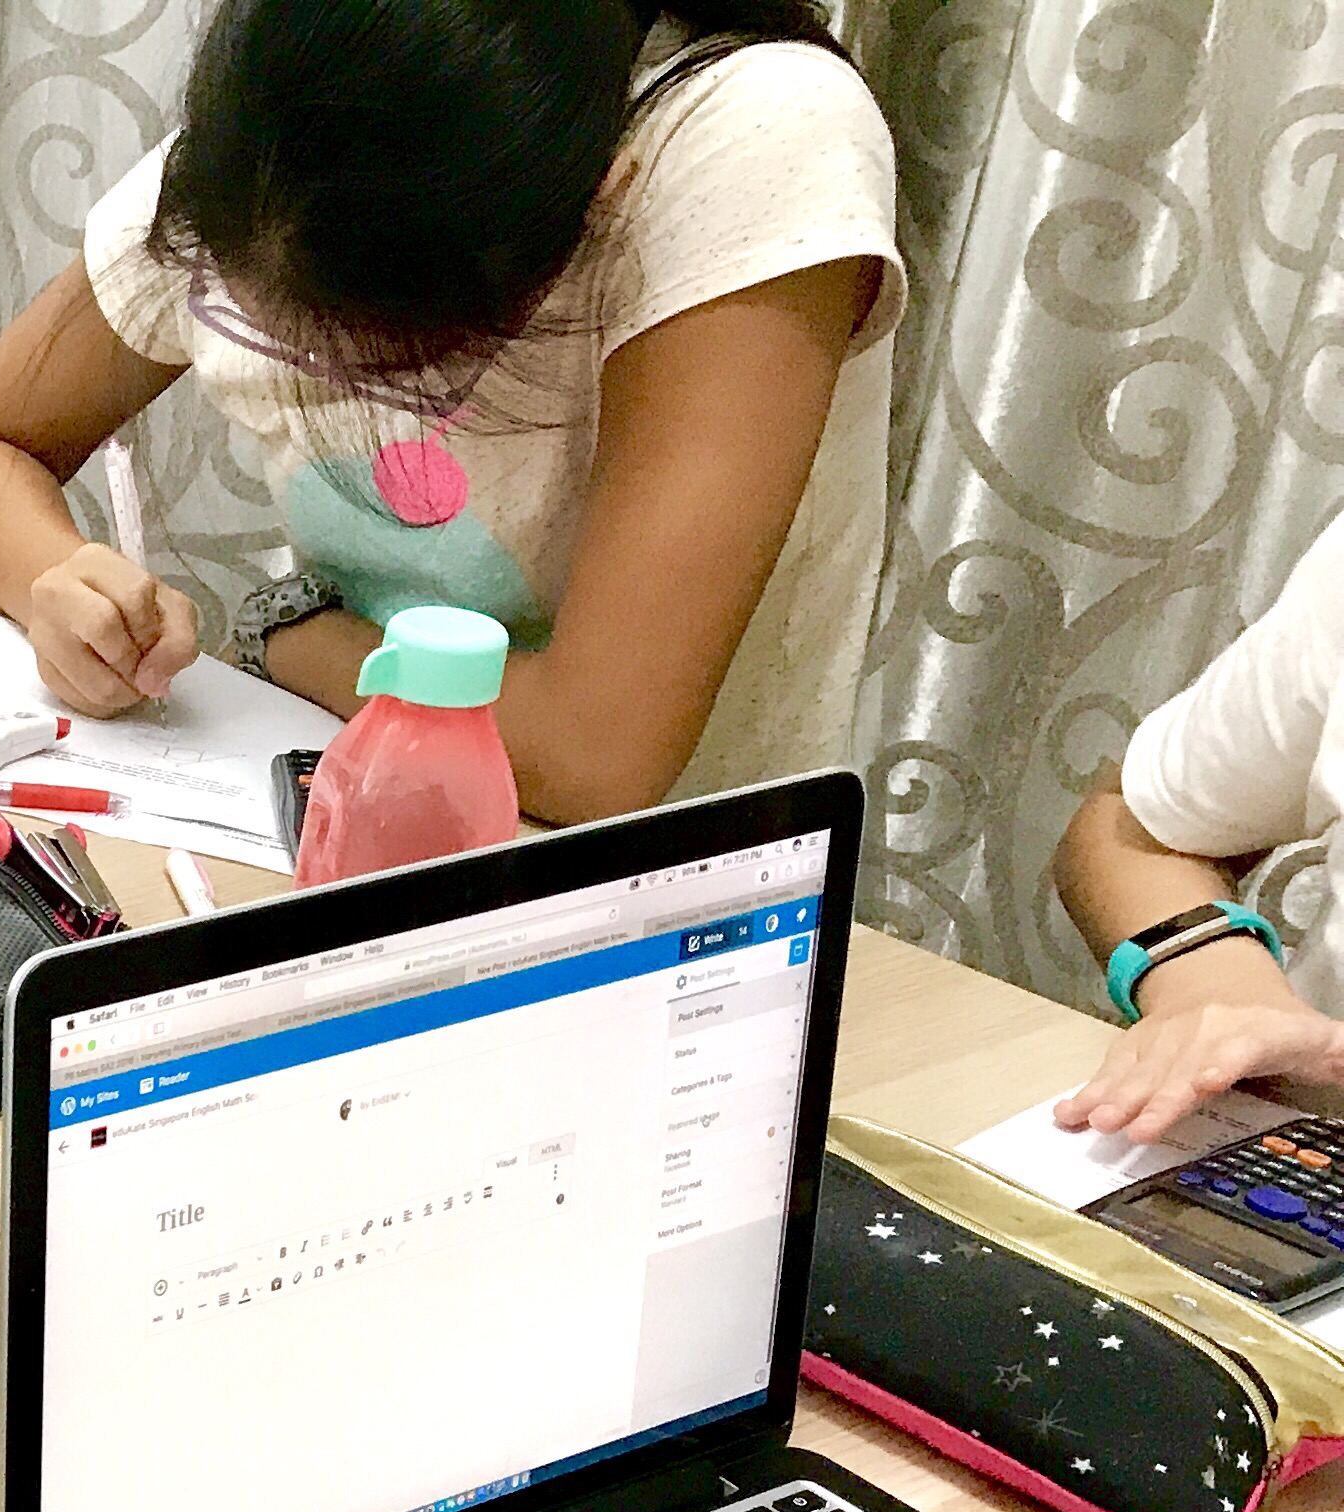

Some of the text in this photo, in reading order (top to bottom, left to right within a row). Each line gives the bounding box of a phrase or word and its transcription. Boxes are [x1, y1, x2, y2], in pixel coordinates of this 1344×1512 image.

[722, 856, 733, 867] Fri
[751, 849, 763, 861] PM
[704, 931, 724, 945] Write
[89, 943, 384, 1024] Safari File Edit View History Bookmarks Window Help
[689, 964, 736, 984] Post Settings
[678, 1002, 724, 1022] Post Settings
[674, 1047, 697, 1059] Status
[80, 1071, 190, 1110] My Sites Reader
[671, 1072, 733, 1096] Categories Tags
[148, 1110, 189, 1131] Singapore
[191, 1100, 220, 1118] English
[222, 1094, 243, 1109] Math
[496, 1143, 562, 1169] Visual HTML
[665, 1148, 692, 1162] Sharing
[661, 1179, 702, 1198] Post Format
[156, 1204, 205, 1234] Title
[658, 1220, 702, 1239] More Options
[197, 1261, 239, 1281] Paragraph
